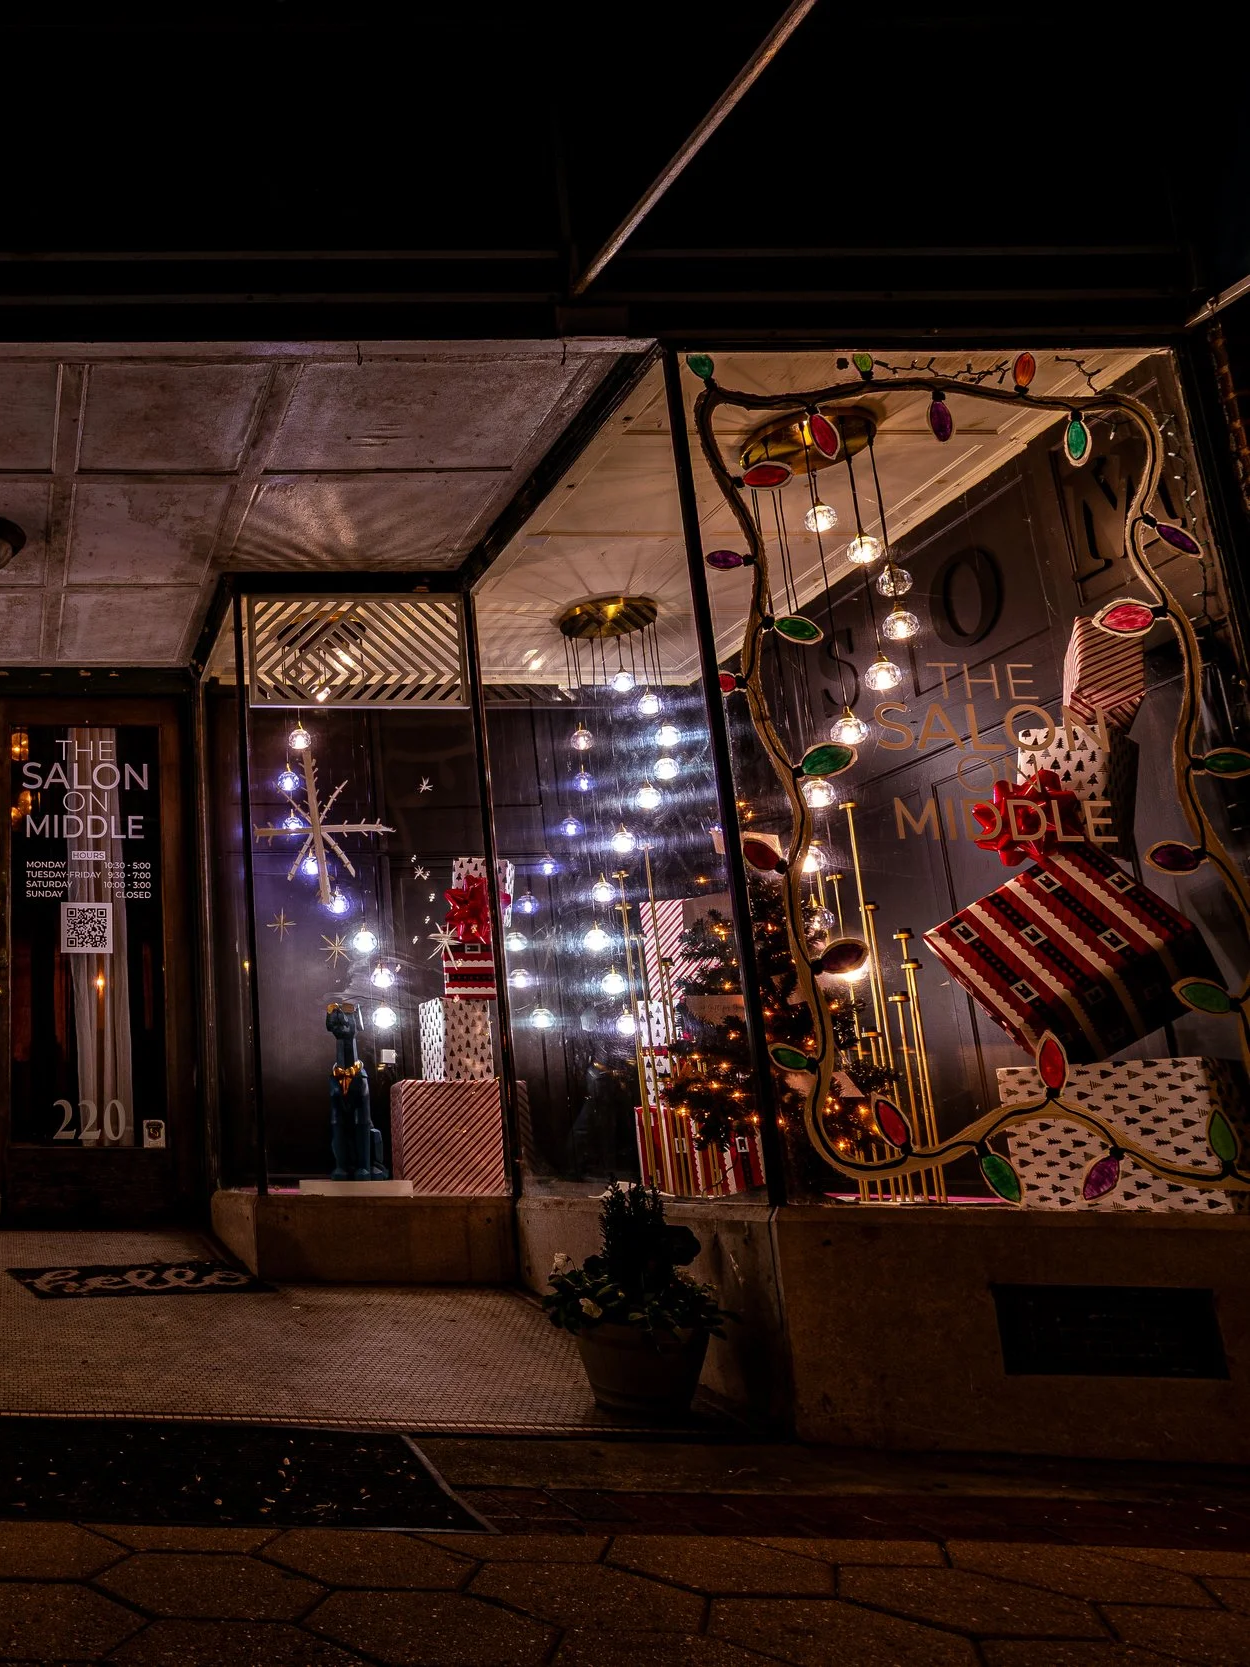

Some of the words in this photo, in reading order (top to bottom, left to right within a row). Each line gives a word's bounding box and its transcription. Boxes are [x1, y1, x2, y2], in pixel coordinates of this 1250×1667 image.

[928, 544, 1005, 648] O
[925, 662, 1040, 701] THE
[872, 701, 1111, 753] SALON
[55, 739, 115, 761] THE
[22, 761, 149, 791] SALON
[956, 753, 1042, 794] ON
[62, 791, 108, 812] ON
[25, 814, 145, 839] MIDDLE
[893, 796, 1120, 843] MIDDLE
[26, 861, 66, 869] MONDAY
[72, 851, 105, 860] HOURS
[25, 870, 102, 879] TUESDAY-FRIDAY
[107, 871, 126, 879] 9:30
[132, 871, 151, 879] 7:00
[25, 880, 73, 888] SATURDAY
[103, 881, 126, 889] 10:00
[132, 881, 152, 889] 3:00
[25, 890, 64, 898] SUNDAY
[115, 891, 152, 899] CLOSED
[52, 1099, 126, 1140] 220
[25, 1268, 249, 1292] hello
